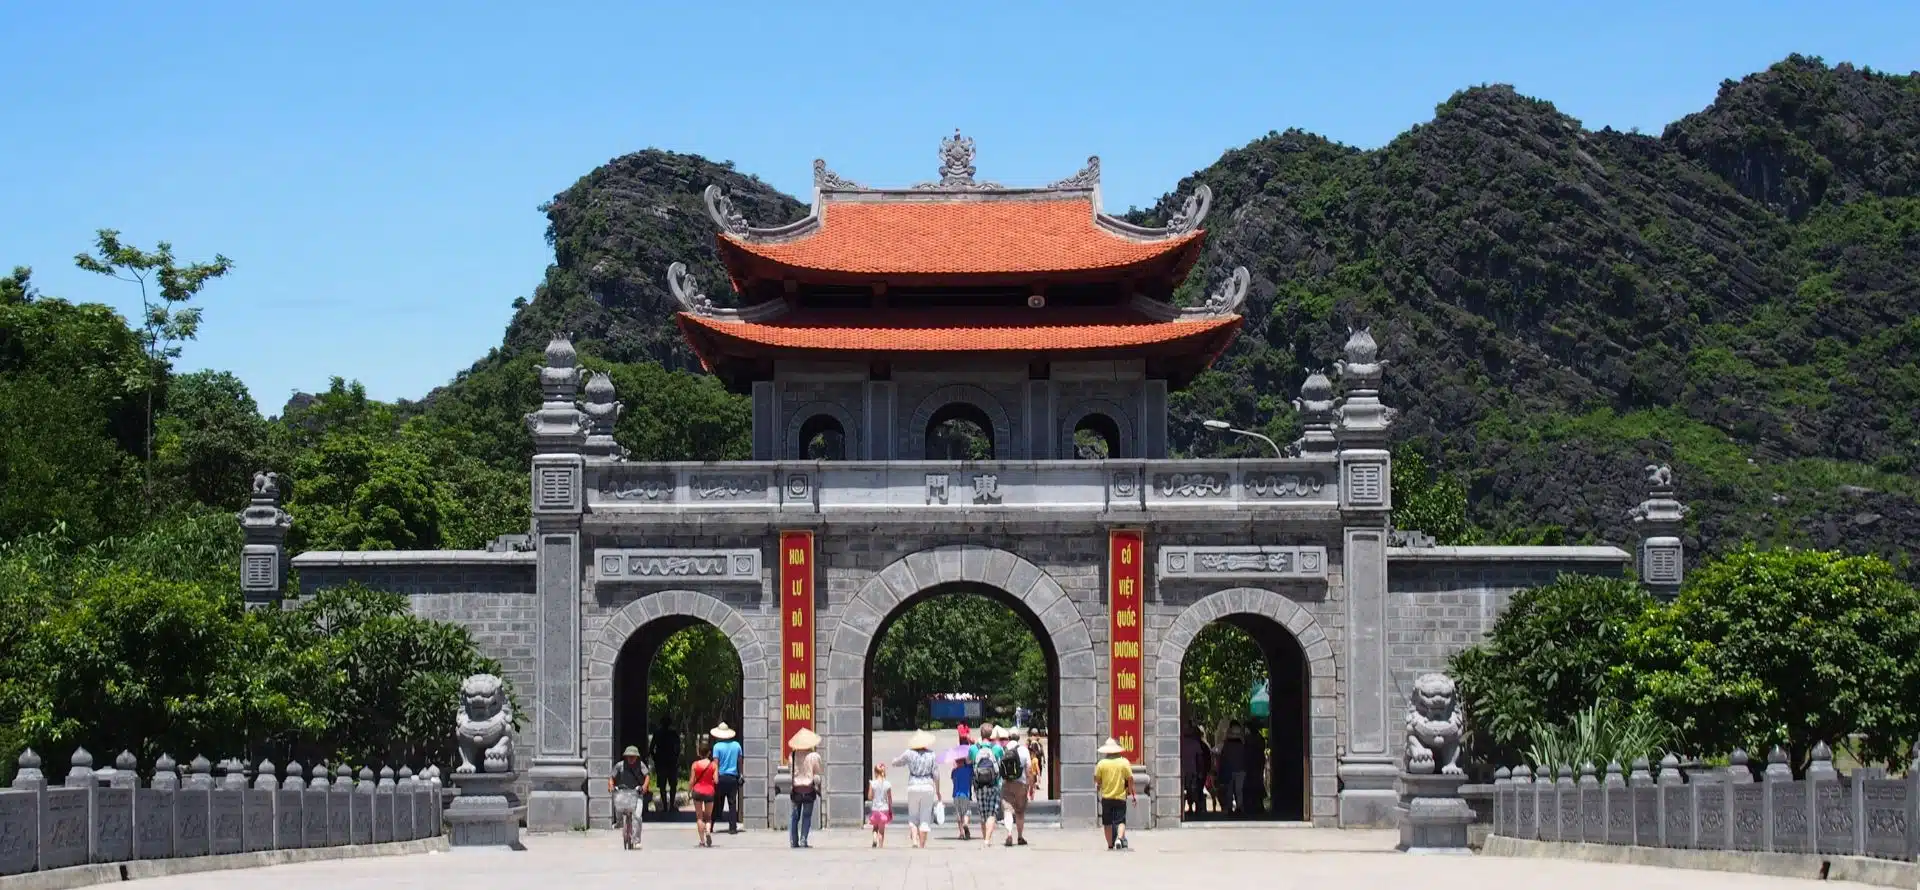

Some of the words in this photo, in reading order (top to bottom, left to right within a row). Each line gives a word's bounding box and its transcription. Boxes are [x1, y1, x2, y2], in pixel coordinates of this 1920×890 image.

[789, 549, 805, 565] HOA
[1119, 575, 1135, 599] VIỆT
[1118, 703, 1135, 721] KHAI
